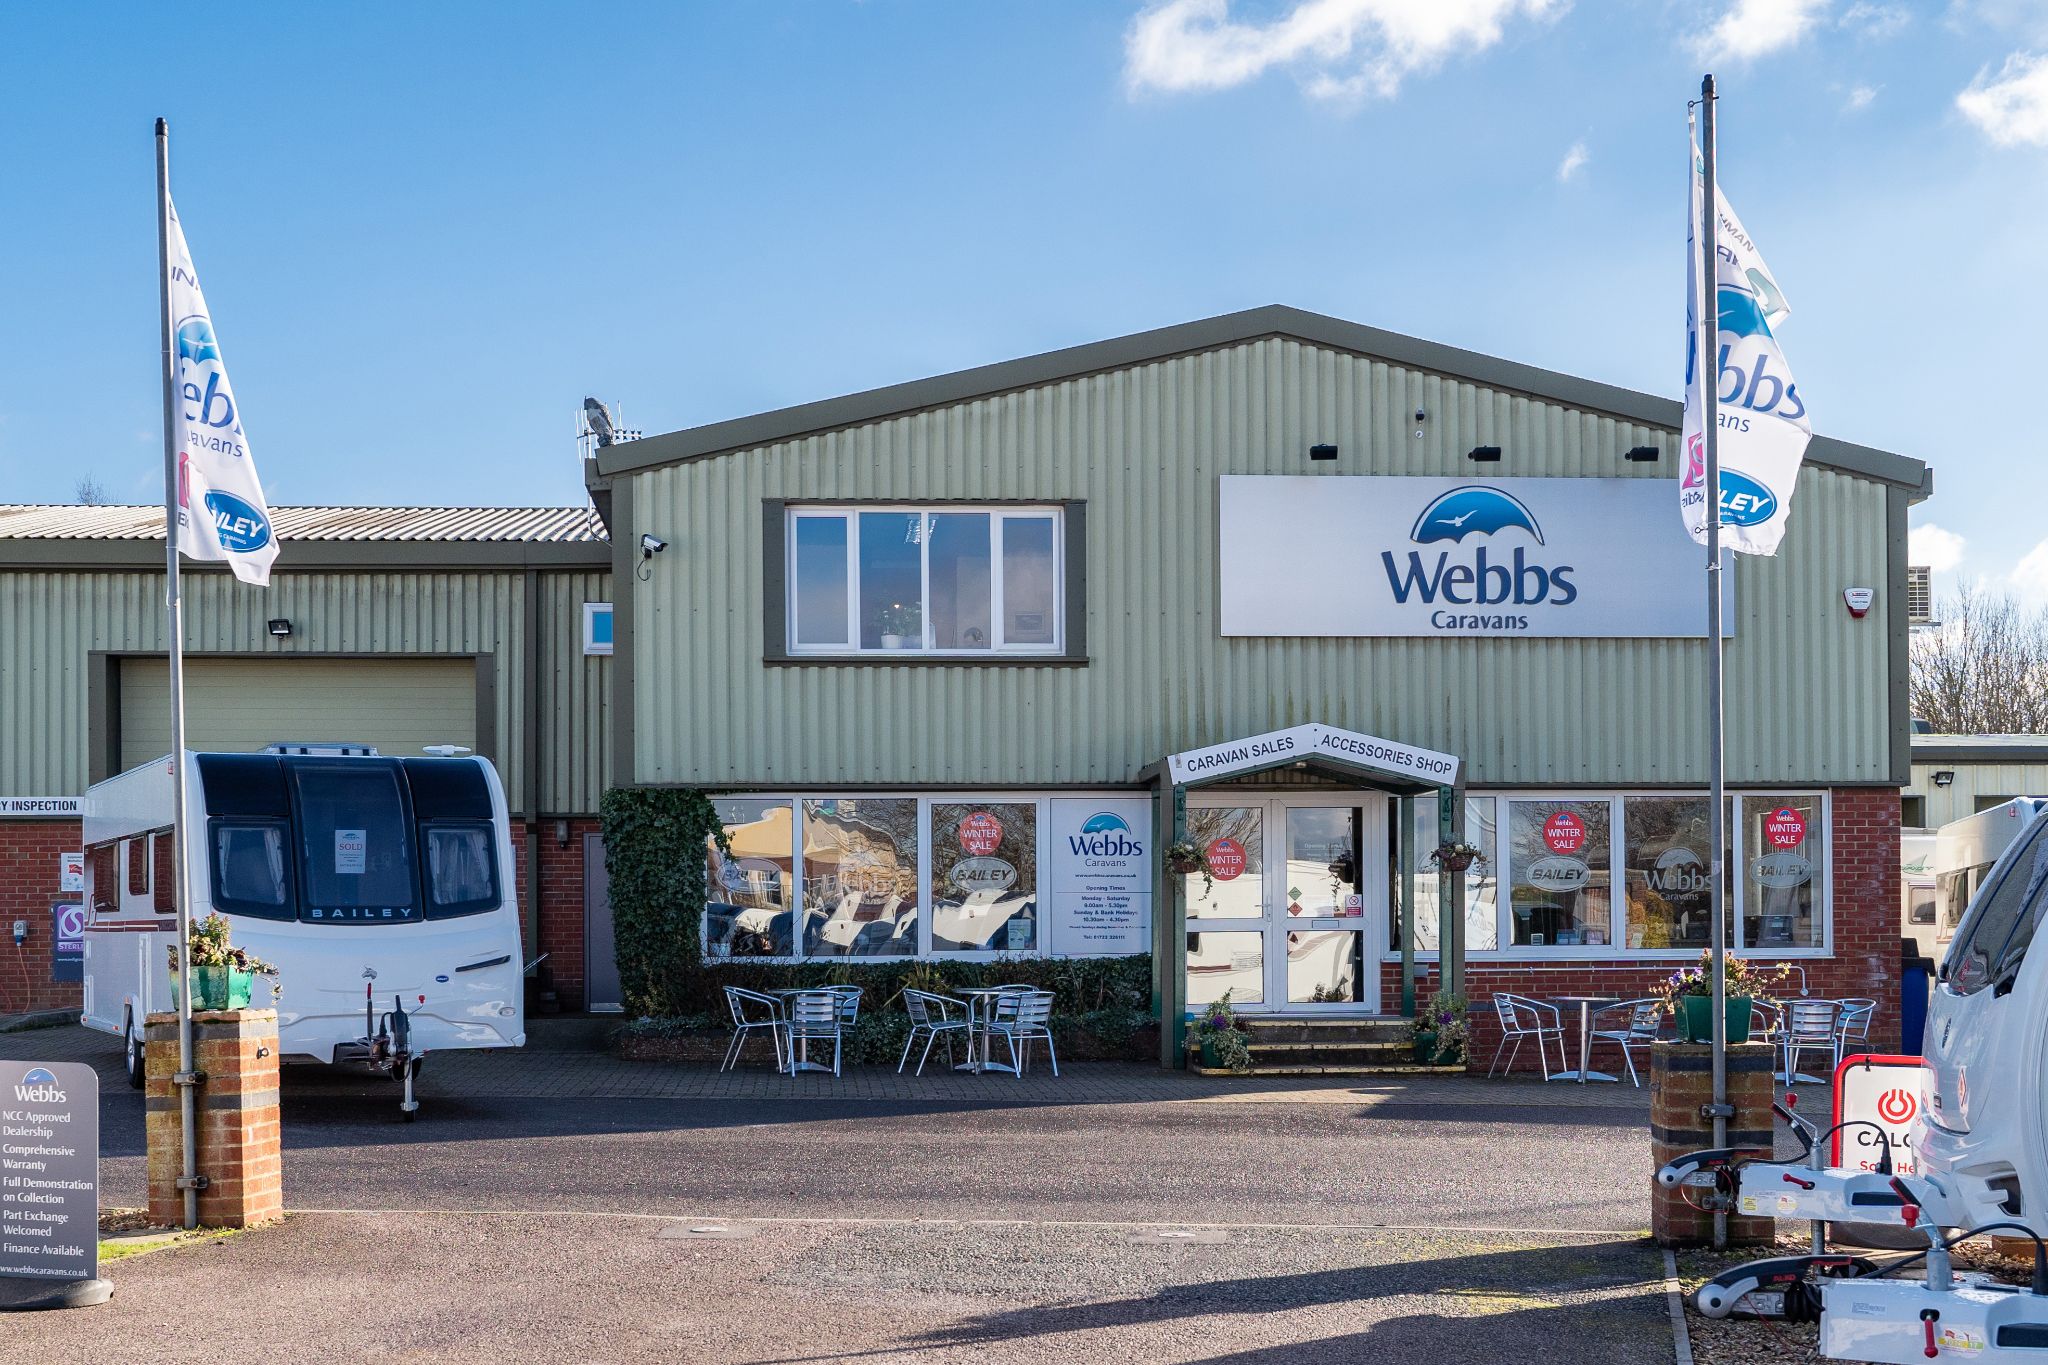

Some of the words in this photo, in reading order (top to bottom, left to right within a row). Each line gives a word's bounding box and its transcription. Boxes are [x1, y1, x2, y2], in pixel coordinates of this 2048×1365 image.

[1718, 344, 1805, 419] bbs
[1720, 489, 1770, 513] LEY
[216, 511, 264, 538] ILEY
[1381, 546, 1577, 605] Webbs
[1431, 610, 1528, 630] Caravans
[1187, 747, 1250, 773] CARAVAN
[1252, 736, 1294, 758] SALES
[1321, 734, 1413, 767] ACCESSORIES
[1416, 756, 1452, 775] SHOP
[11, 800, 77, 811] INSPECTION
[963, 829, 998, 838] WINTER
[1548, 828, 1581, 837] WINTER
[1769, 824, 1802, 833] WINTER
[970, 841, 992, 850] SALE
[1069, 834, 1143, 856] Webbs
[1554, 839, 1575, 849] SALE
[1775, 835, 1796, 844] SALE
[339, 843, 362, 851] SOLD
[1085, 858, 1126, 867] Caravans
[1208, 855, 1242, 864] WINTER
[956, 869, 1012, 881] BAILEY
[1214, 867, 1236, 876] SALE
[1532, 869, 1584, 880] BAILEY
[1660, 892, 1699, 901] Caravans
[312, 908, 412, 918] BAILEY
[14, 1085, 67, 1104] Webbs
[3, 1111, 23, 1121] NCC
[26, 1112, 71, 1125] Approved
[3, 1126, 53, 1139] Dealership
[3, 1144, 75, 1157] Comprehensive
[3, 1159, 47, 1173] Warranty
[3, 1177, 21, 1188] Full
[23, 1178, 93, 1190] Demonstration
[3, 1195, 15, 1203] on
[18, 1193, 64, 1204] Collection
[3, 1210, 22, 1221] Part
[24, 1211, 69, 1224] Exchange
[3, 1226, 52, 1237] Welcomed
[3, 1243, 40, 1255] Finance
[42, 1244, 84, 1257] Available
